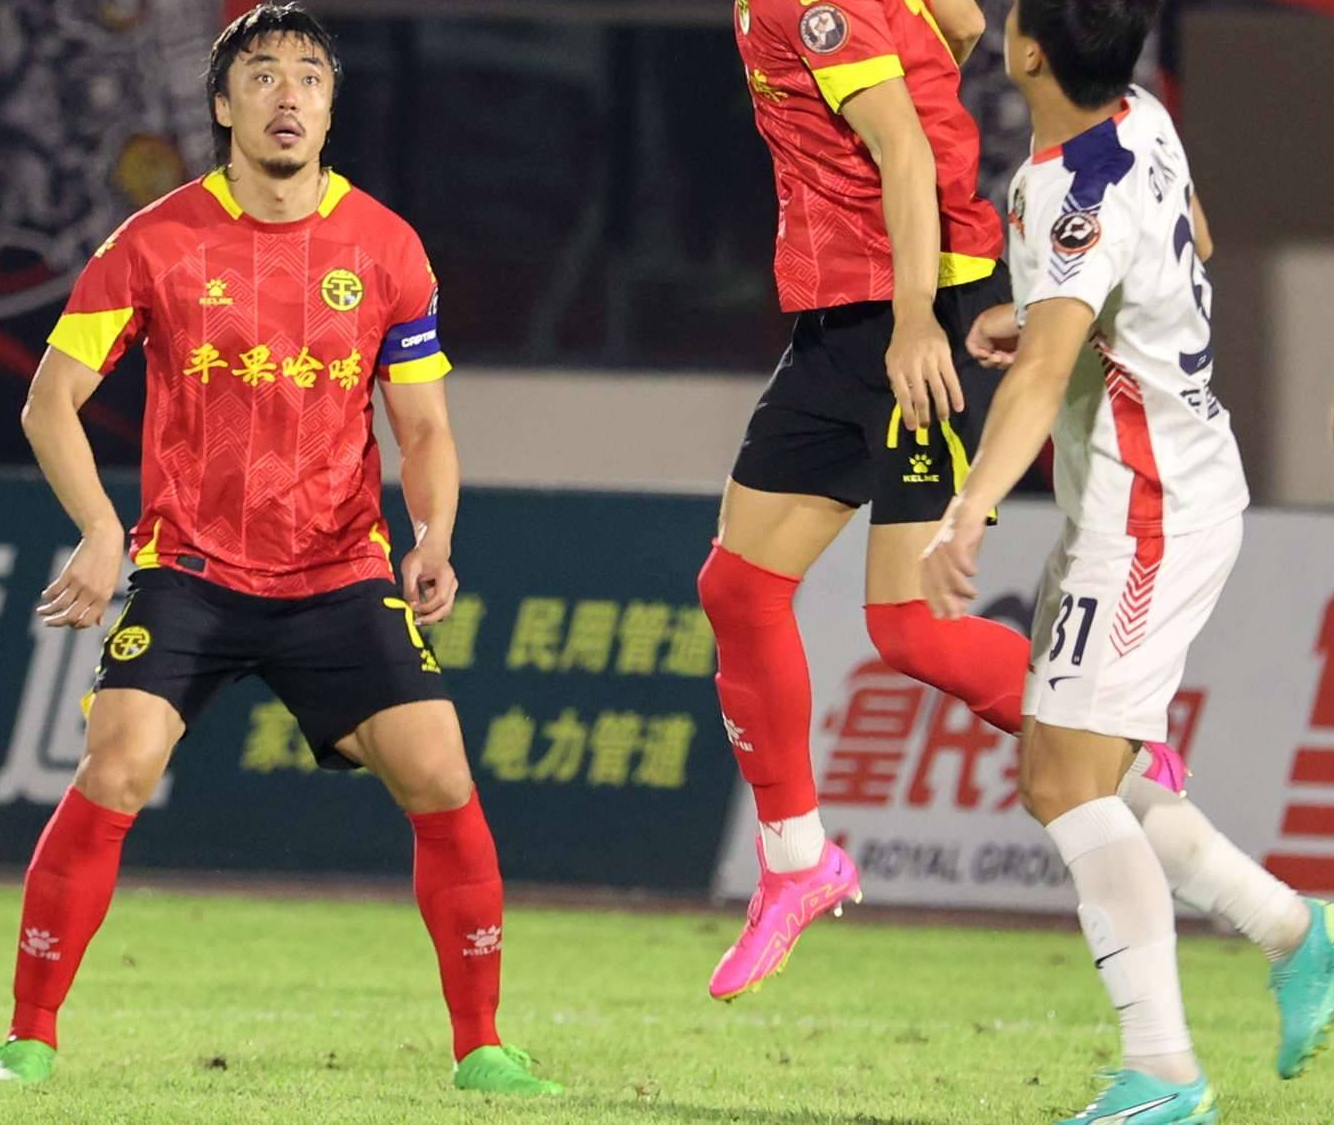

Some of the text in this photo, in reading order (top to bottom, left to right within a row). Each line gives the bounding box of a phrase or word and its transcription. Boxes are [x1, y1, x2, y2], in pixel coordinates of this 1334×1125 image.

[1048, 593, 1098, 667] 31
[480, 705, 695, 788] 电力管道
